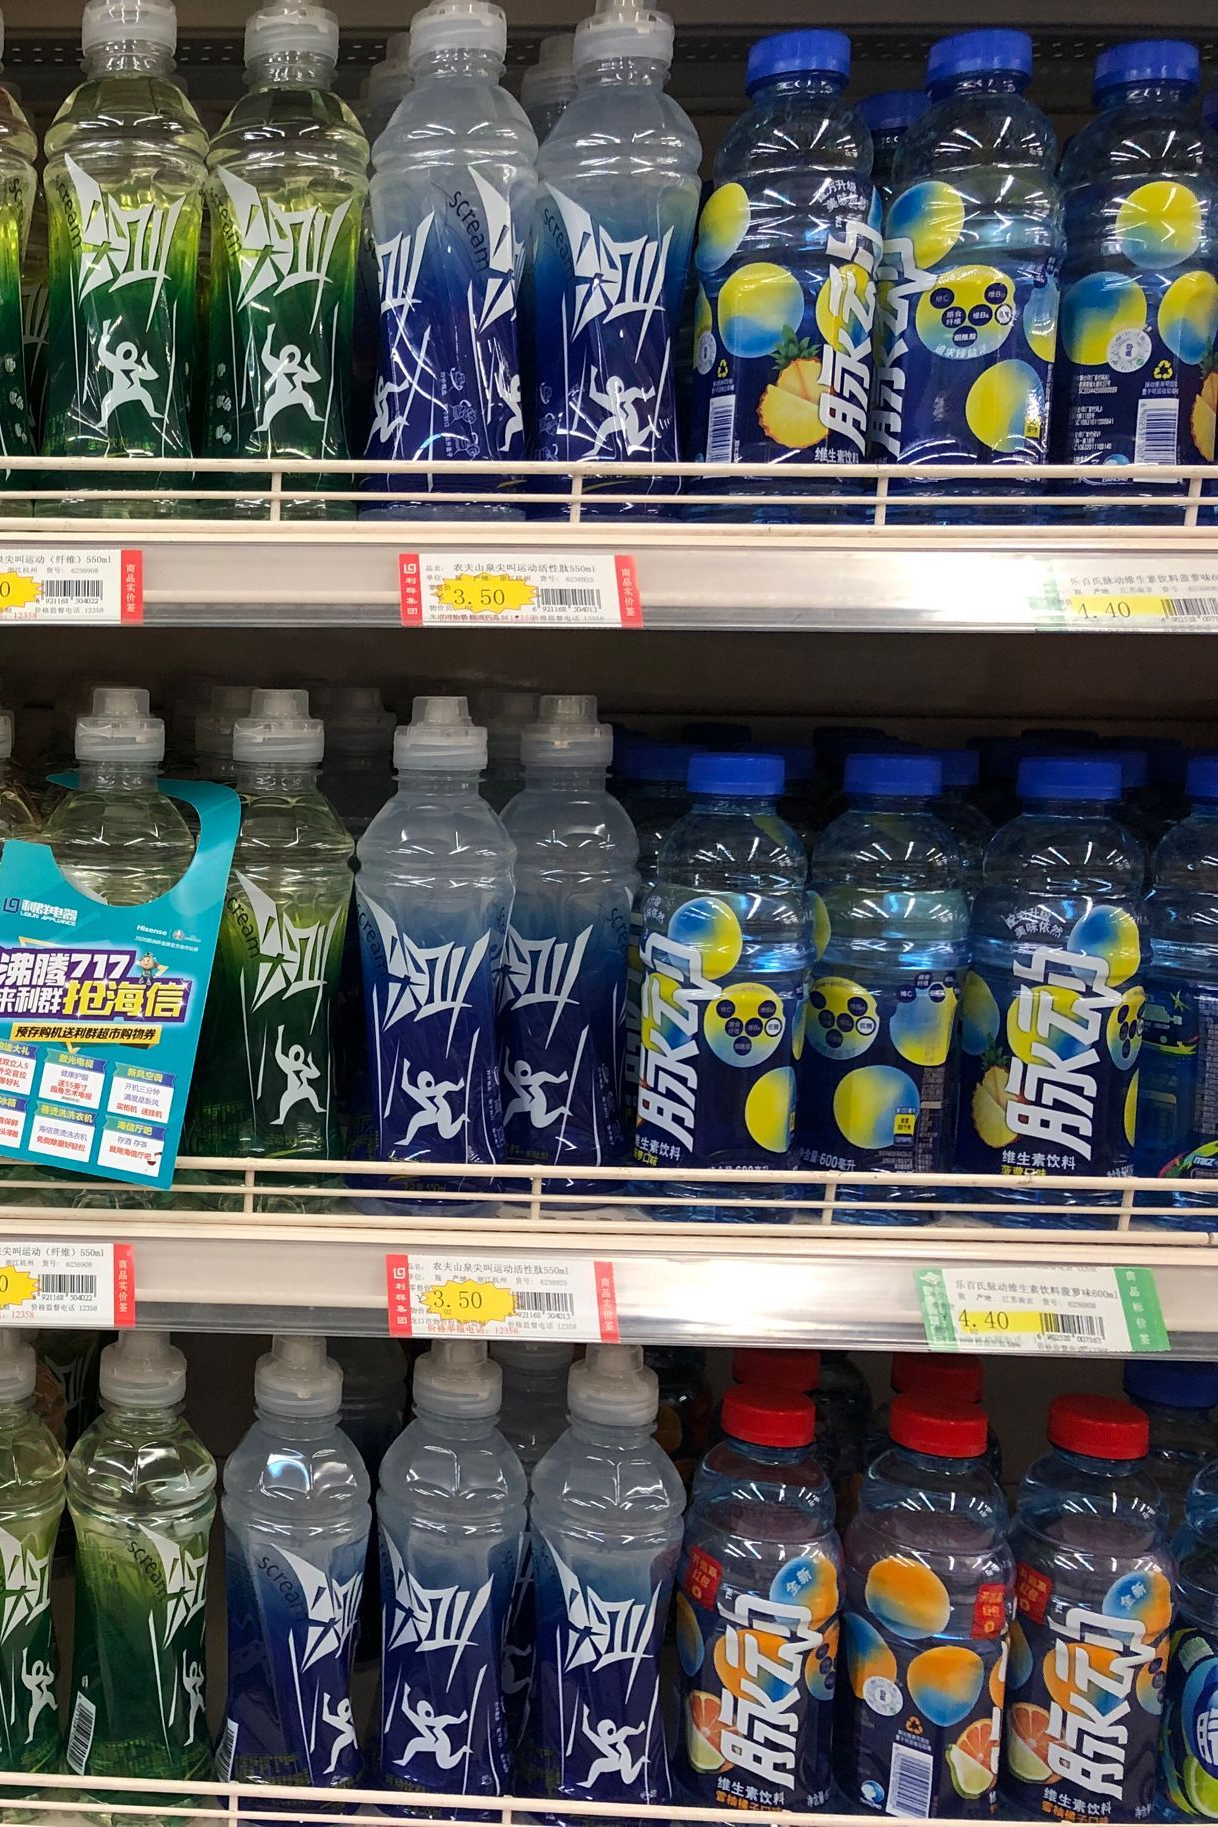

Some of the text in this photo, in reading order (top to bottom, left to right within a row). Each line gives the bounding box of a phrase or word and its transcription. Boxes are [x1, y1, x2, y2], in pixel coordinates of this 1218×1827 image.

[449, 189, 490, 273] scream
[818, 220, 883, 457] 脉动
[453, 588, 505, 606] 3.50
[136, 924, 168, 936] Hisense
[15, 1026, 157, 1041] 预存购机送利群超市购物券
[637, 932, 722, 1152] 脉动
[1006, 946, 1122, 1162] 脉动
[61, 1069, 89, 1081] 健康护眼
[124, 1082, 161, 1097] 开机三分钟
[1001, 1149, 1076, 1171] 维生素饮料
[434, 1290, 483, 1309] 3.50
[958, 1309, 1010, 1330] 4.40
[127, 1540, 168, 1601] scream
[785, 1566, 813, 1596] 全新
[1120, 1580, 1147, 1608] 全新
[717, 1594, 823, 1791] 脉动
[1048, 1607, 1156, 1801] 脉动
[717, 1776, 786, 1806] 维生素饮料
[1043, 1787, 1112, 1816] 维生素饮料
